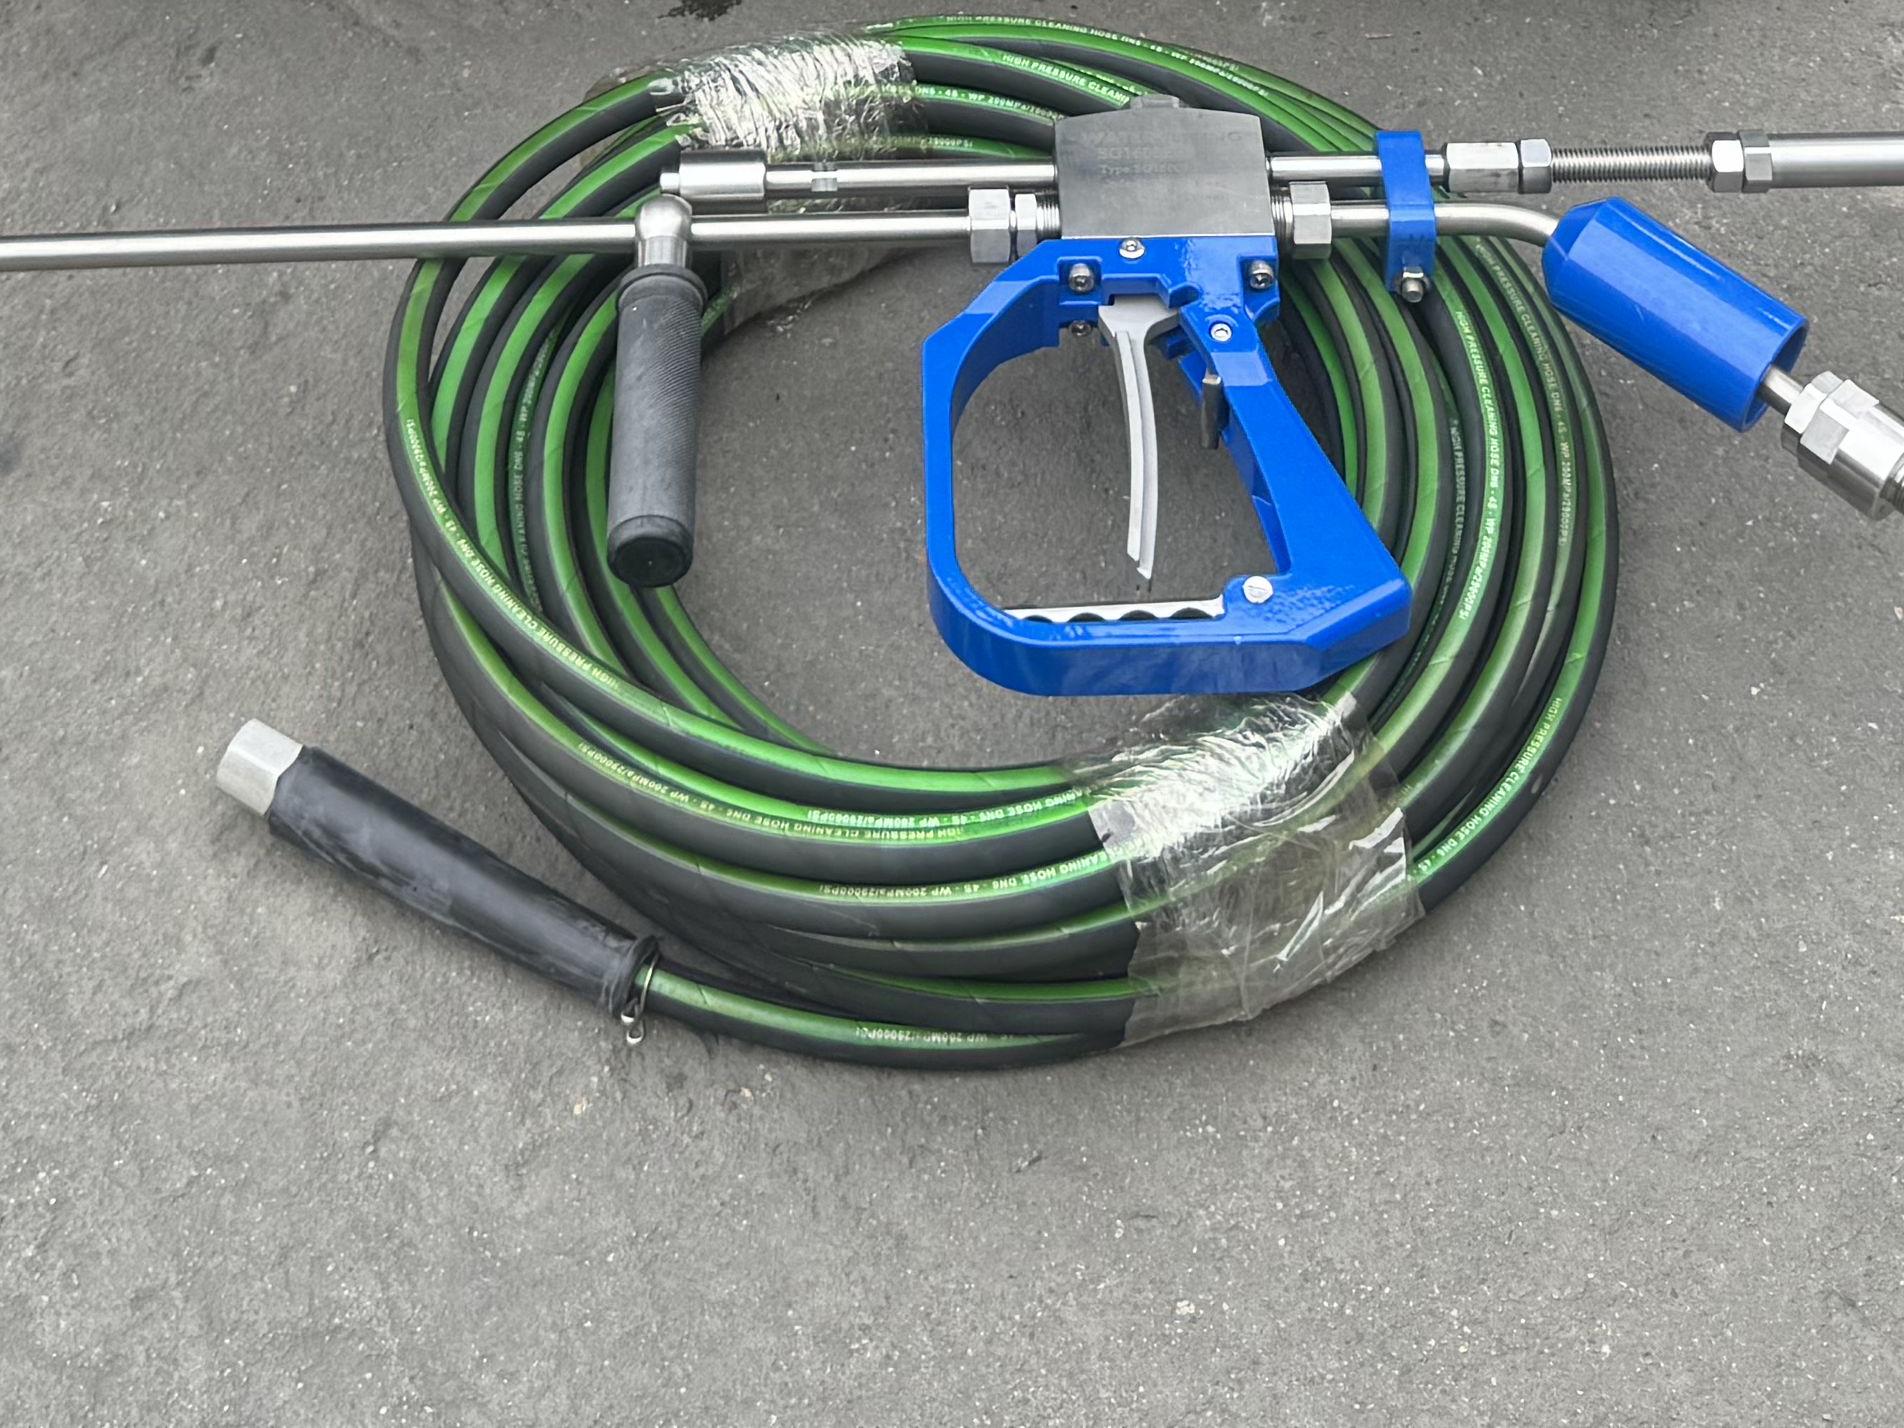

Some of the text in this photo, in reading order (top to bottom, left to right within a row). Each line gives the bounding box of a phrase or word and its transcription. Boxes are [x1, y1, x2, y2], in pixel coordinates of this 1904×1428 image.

[976, 15, 1031, 27] PRESSURE
[1034, 19, 1087, 33] CLEANING
[1002, 53, 1027, 68] HIGH
[1028, 57, 1086, 88] PRESSURE
[968, 92, 985, 104] WP
[1455, 310, 1471, 334] HIGH
[1492, 262, 1525, 312] PRESSURE
[1520, 312, 1546, 365] CLEANING
[1465, 332, 1489, 386] PRESSURE
[1481, 386, 1500, 436] CLEANING
[1487, 436, 1500, 465] HOSE
[469, 558, 497, 588] HOSE
[493, 584, 540, 632] CLEANING
[538, 626, 590, 671] PRESSURE
[1545, 697, 1563, 719] HIGH
[1518, 720, 1551, 774] PRESSURE
[669, 789, 691, 803] WP
[1479, 771, 1520, 817] CLEANING
[919, 815, 940, 827] WP
[1006, 801, 1042, 817] HOSE
[754, 818, 790, 831] HOSE
[794, 821, 870, 839] CLEANING
[872, 826, 939, 841] PRESSURE
[1457, 810, 1485, 841] HOSE
[1022, 865, 1056, 885] HOSE
[931, 885, 952, 896] WP
